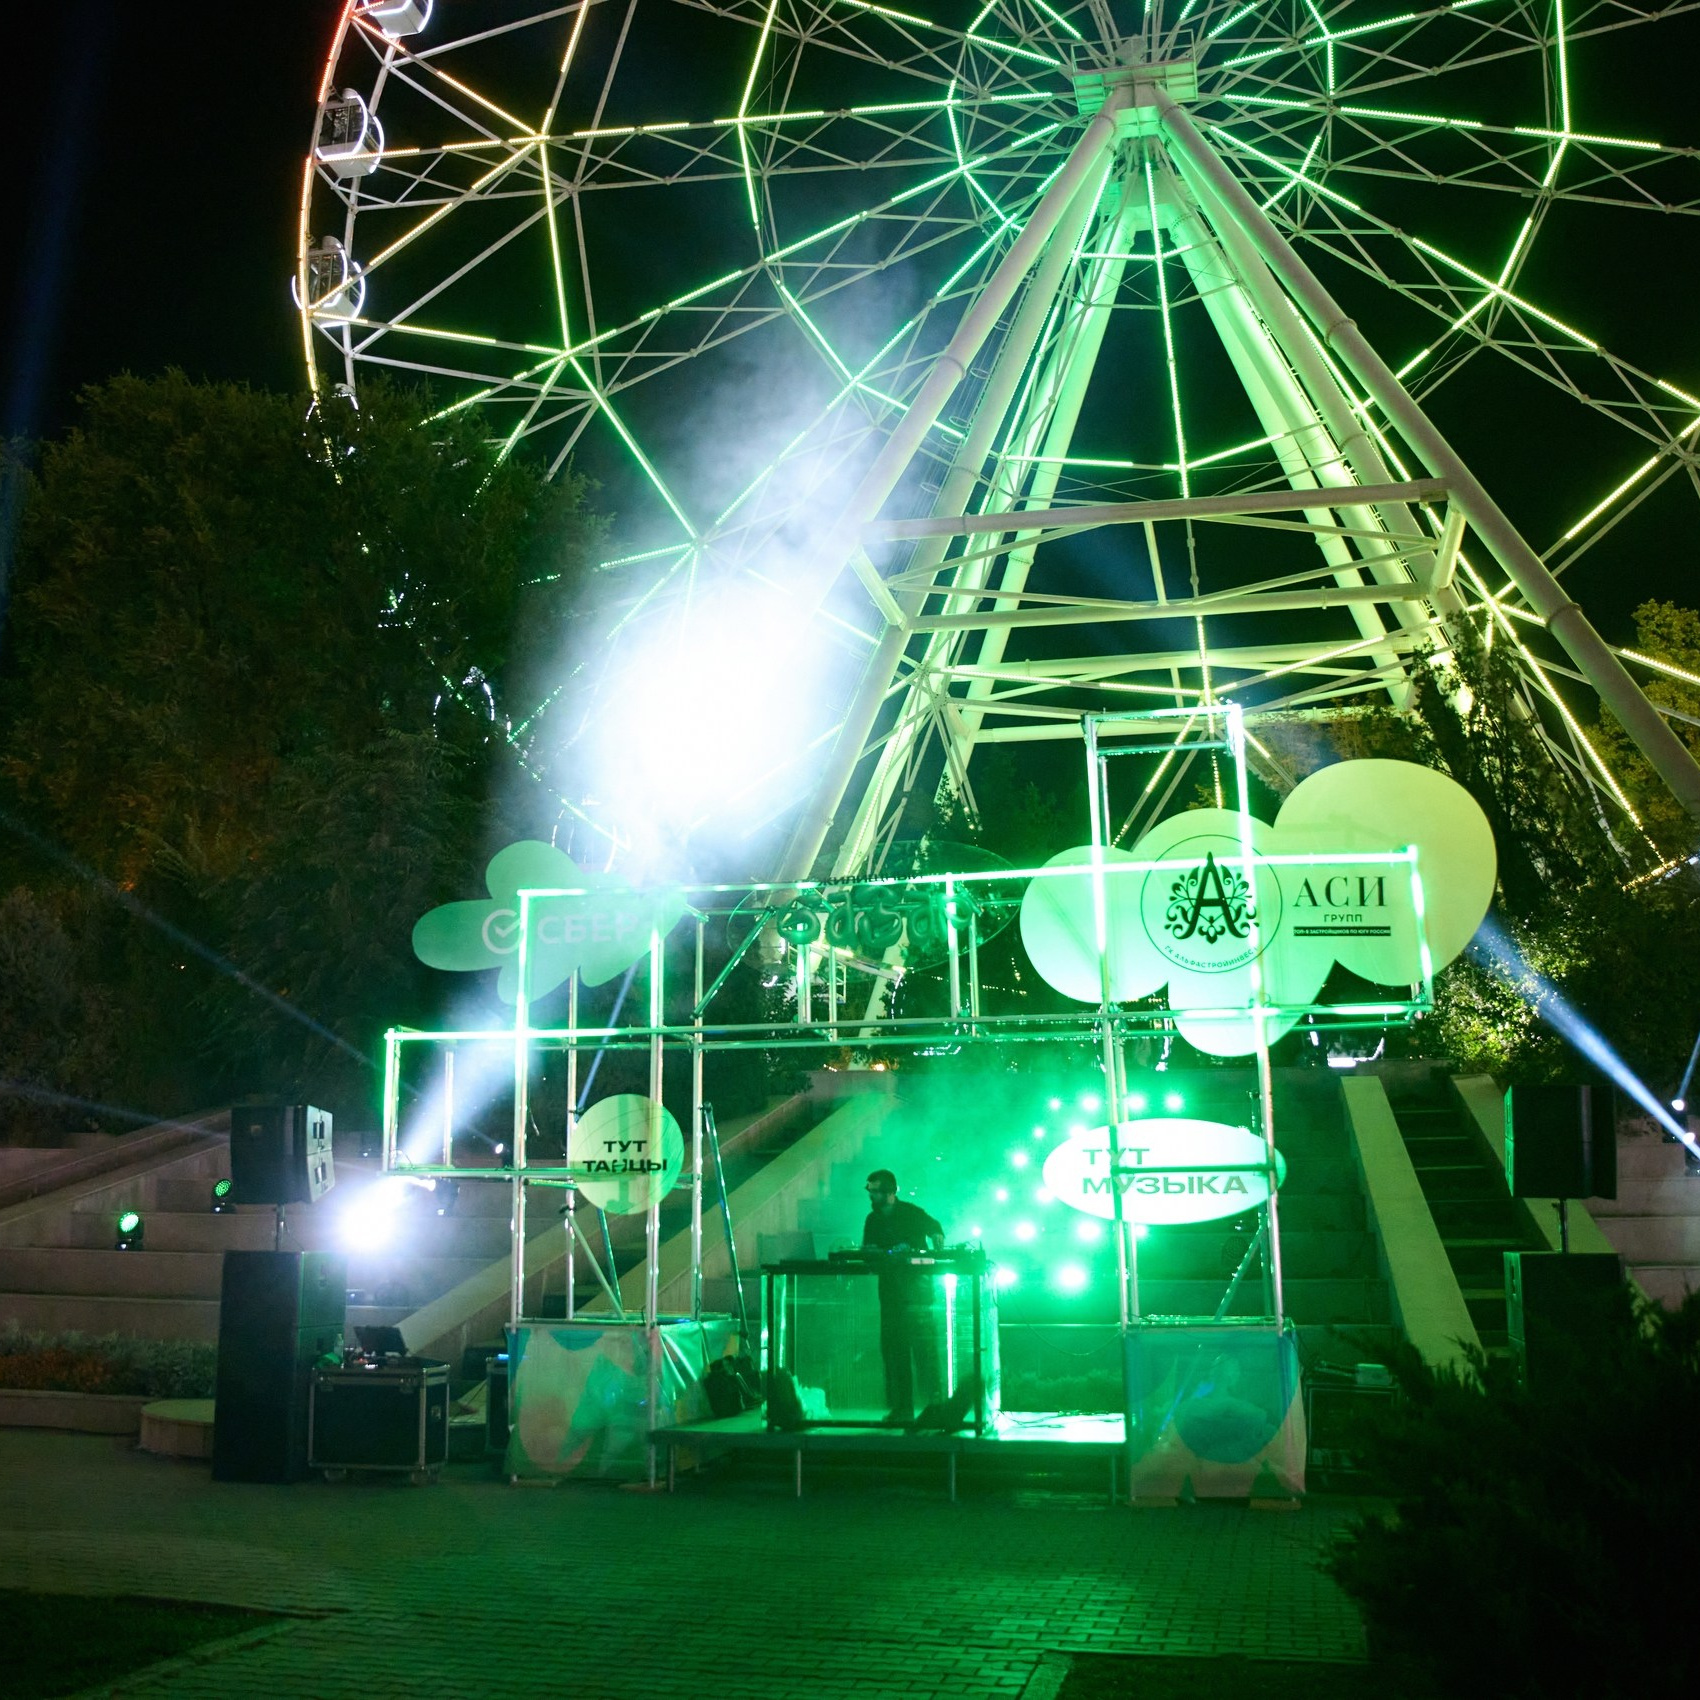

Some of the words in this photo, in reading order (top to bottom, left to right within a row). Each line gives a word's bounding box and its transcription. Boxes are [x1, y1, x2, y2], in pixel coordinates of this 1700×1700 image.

[1292, 875, 1388, 907] АСИ
[1323, 914, 1363, 923] ГРУПП
[537, 911, 639, 945] СБЕР
[1164, 945, 1174, 955] ГК
[1174, 946, 1257, 968] АЛЬФАСТРОЙИНВЕС
[603, 1140, 648, 1153] ТУТ
[1082, 1148, 1151, 1165] ТУТ
[582, 1160, 668, 1173] ТАНЦЫ
[1082, 1175, 1249, 1195] МУЗЫКА
